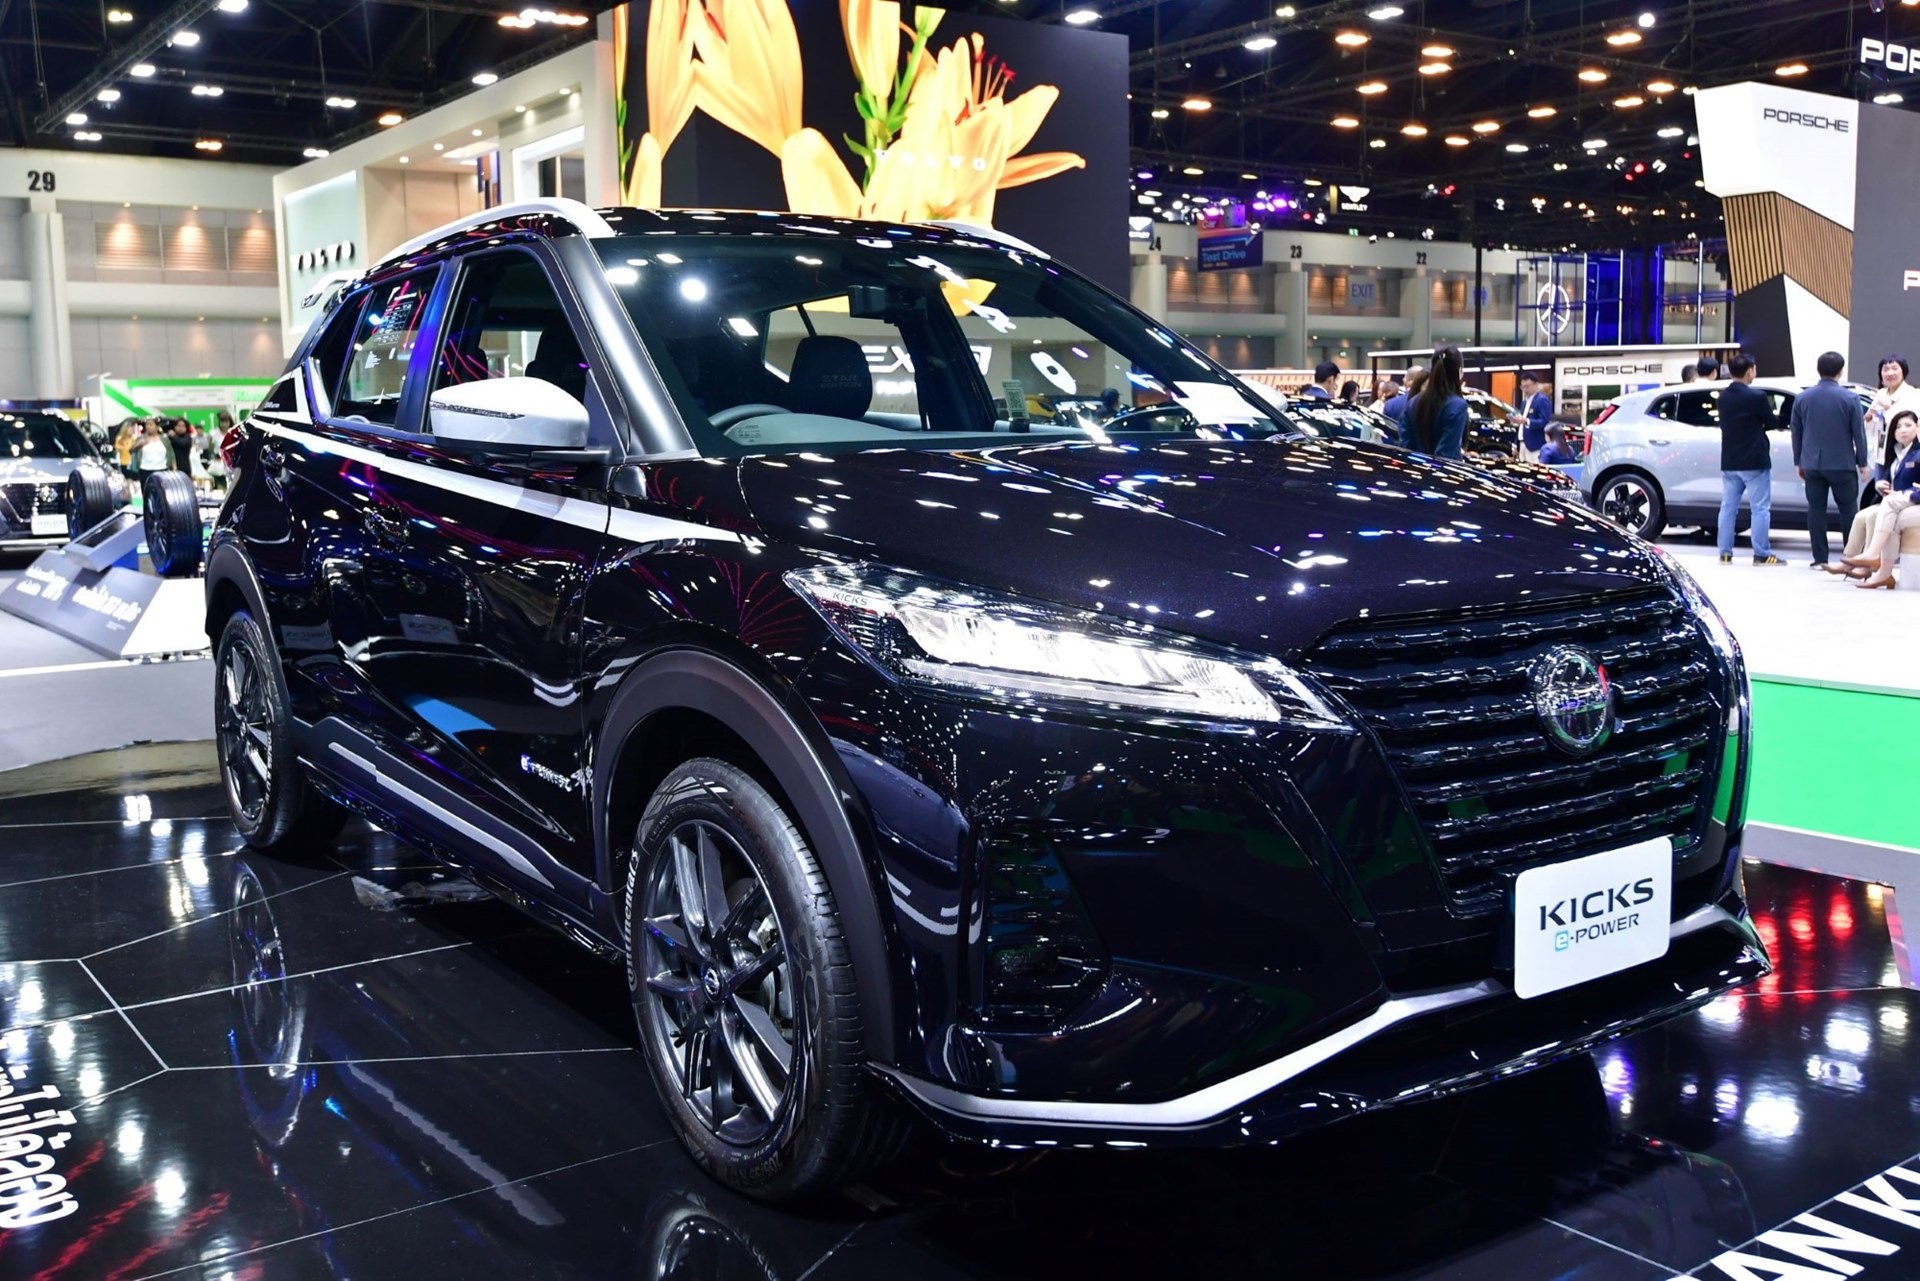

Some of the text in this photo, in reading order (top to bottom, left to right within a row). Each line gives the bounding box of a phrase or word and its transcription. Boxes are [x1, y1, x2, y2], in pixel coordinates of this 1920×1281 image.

[1763, 107, 1849, 133] PORSCHE
[27, 169, 56, 193] 29
[1202, 250, 1246, 262] Test Drive
[1290, 245, 1302, 259] 23
[1416, 252, 1427, 265] 22
[1351, 283, 1374, 298] EXIT
[1563, 363, 1663, 376] PORSCHE
[1539, 877, 1654, 931] KICKS
[1555, 913, 1640, 952] e-POWER
